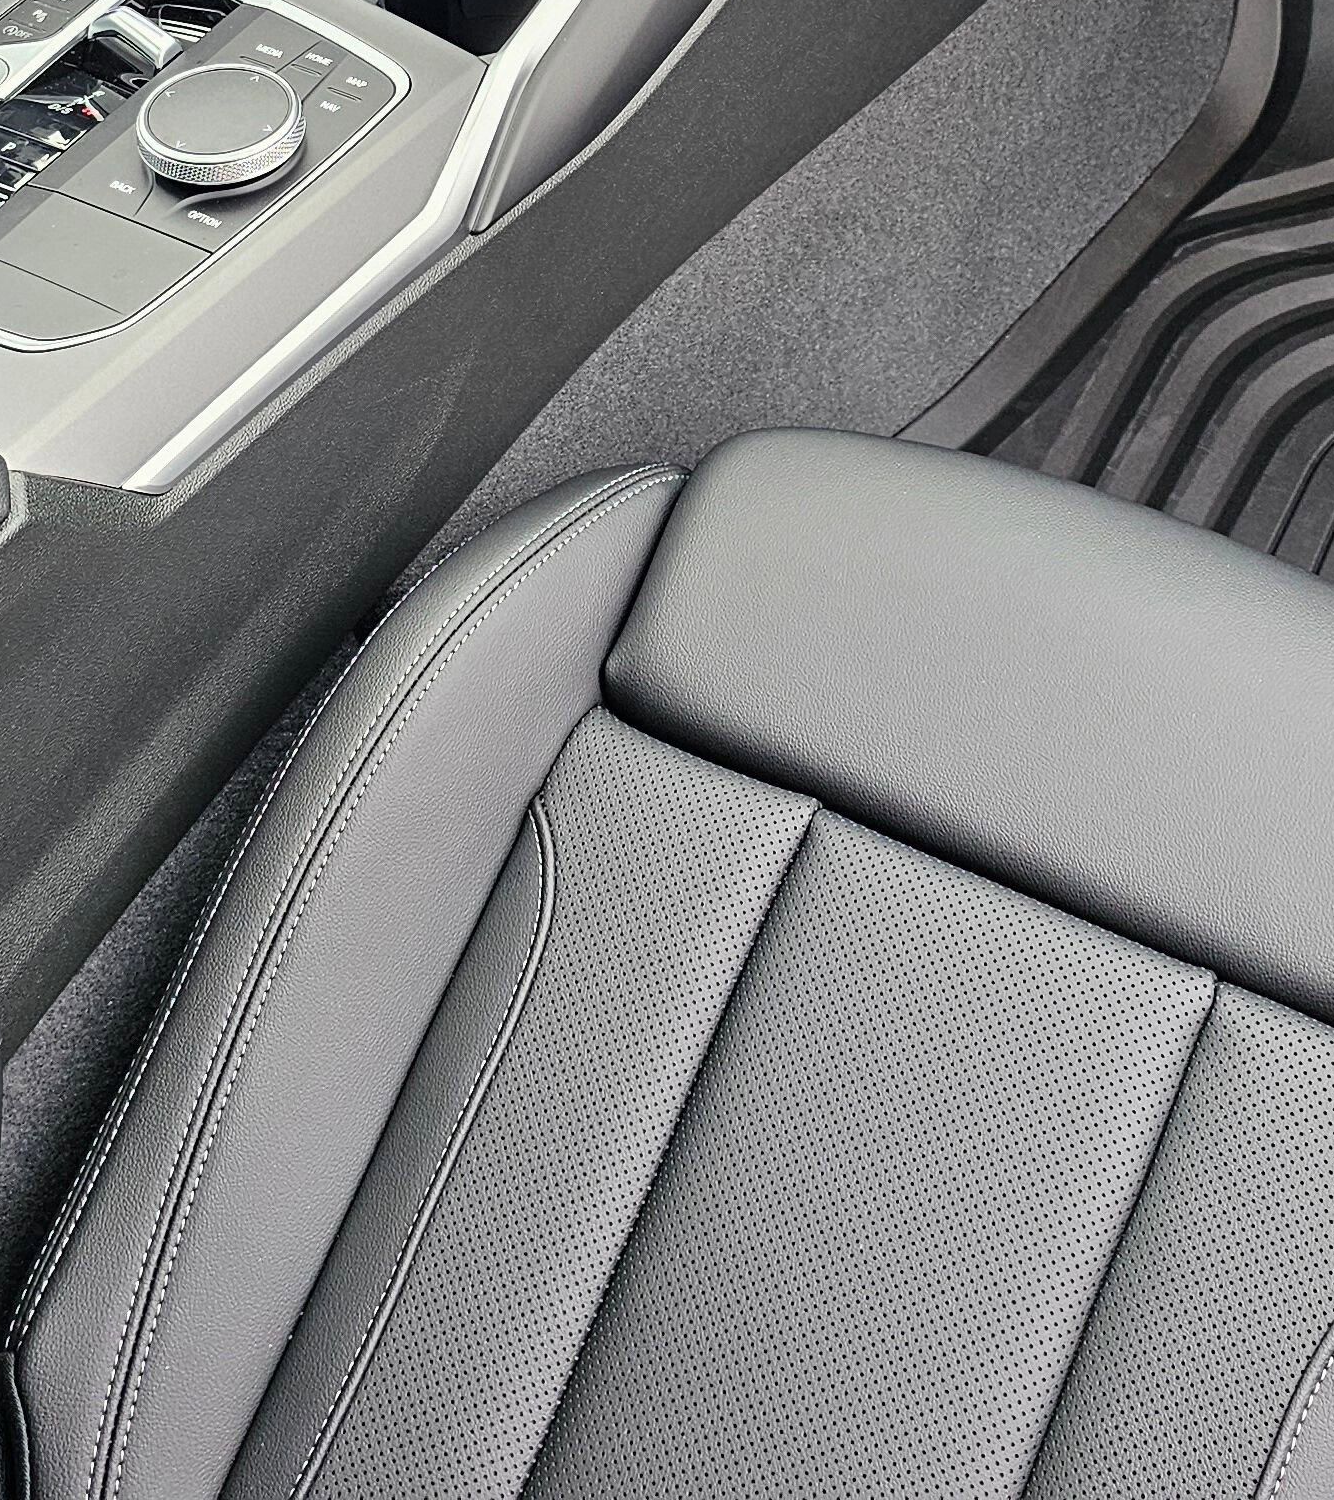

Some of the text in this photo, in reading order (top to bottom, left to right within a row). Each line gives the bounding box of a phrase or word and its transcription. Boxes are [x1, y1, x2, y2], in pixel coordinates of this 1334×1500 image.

[15, 30, 33, 39] OFF
[255, 43, 284, 59] MEDIA
[305, 52, 334, 66] HOME
[346, 76, 368, 88] MAP
[320, 100, 341, 113] NAV
[1, 142, 16, 152] P
[109, 180, 136, 195] BACK
[187, 210, 222, 229] OPTION
